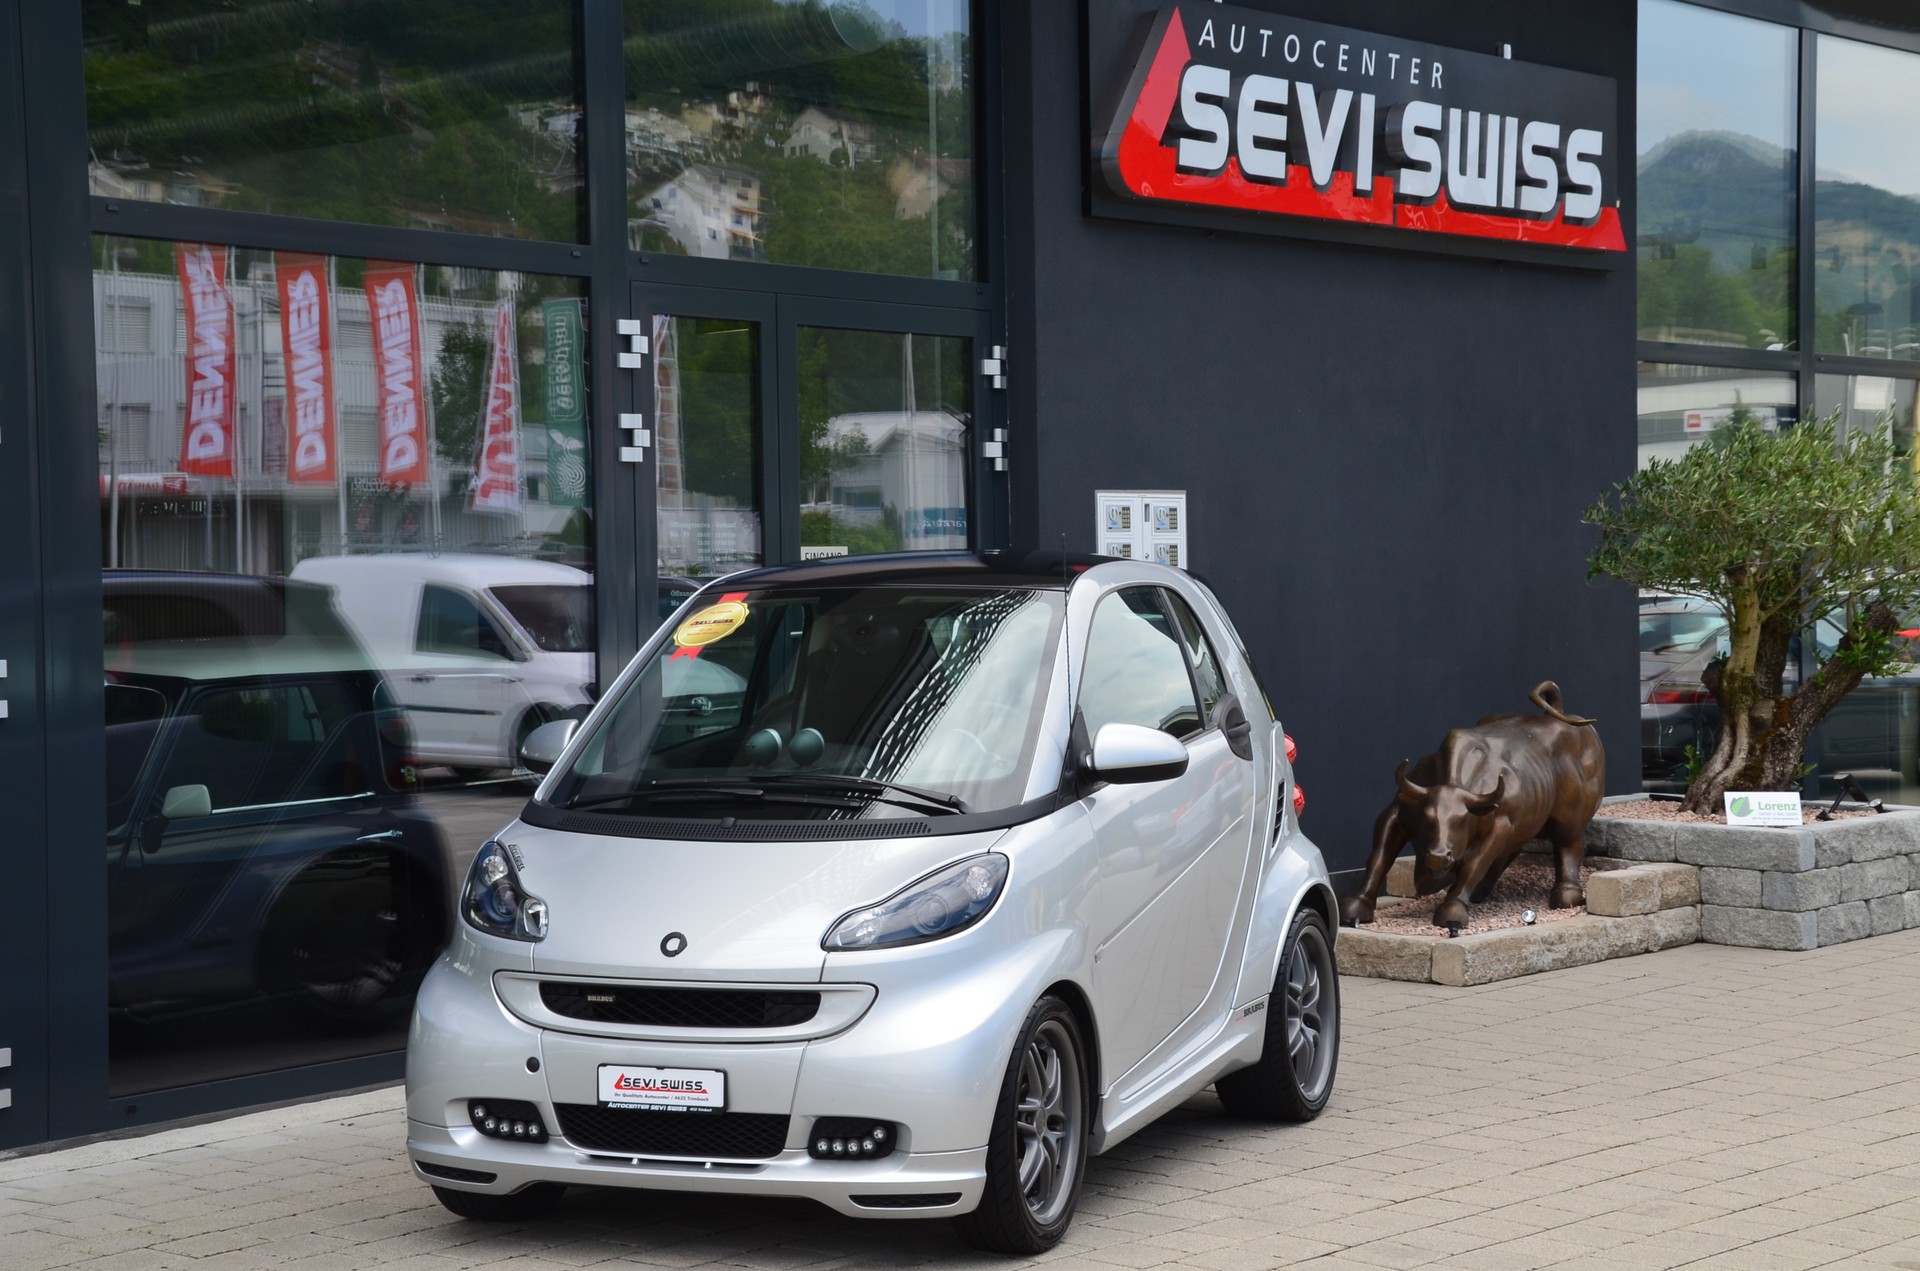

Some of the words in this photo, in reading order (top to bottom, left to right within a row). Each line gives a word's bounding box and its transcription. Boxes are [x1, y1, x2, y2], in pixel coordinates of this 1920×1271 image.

[1199, 19, 1444, 89] AUTOCENTER
[1176, 64, 1375, 192] SEVI
[1400, 100, 1603, 219] SWISS
[1758, 801, 1797, 811] Lorenz
[1243, 1002, 1265, 1017] BRABUS
[623, 1077, 657, 1088] SEVI
[660, 1079, 703, 1091] SWISS
